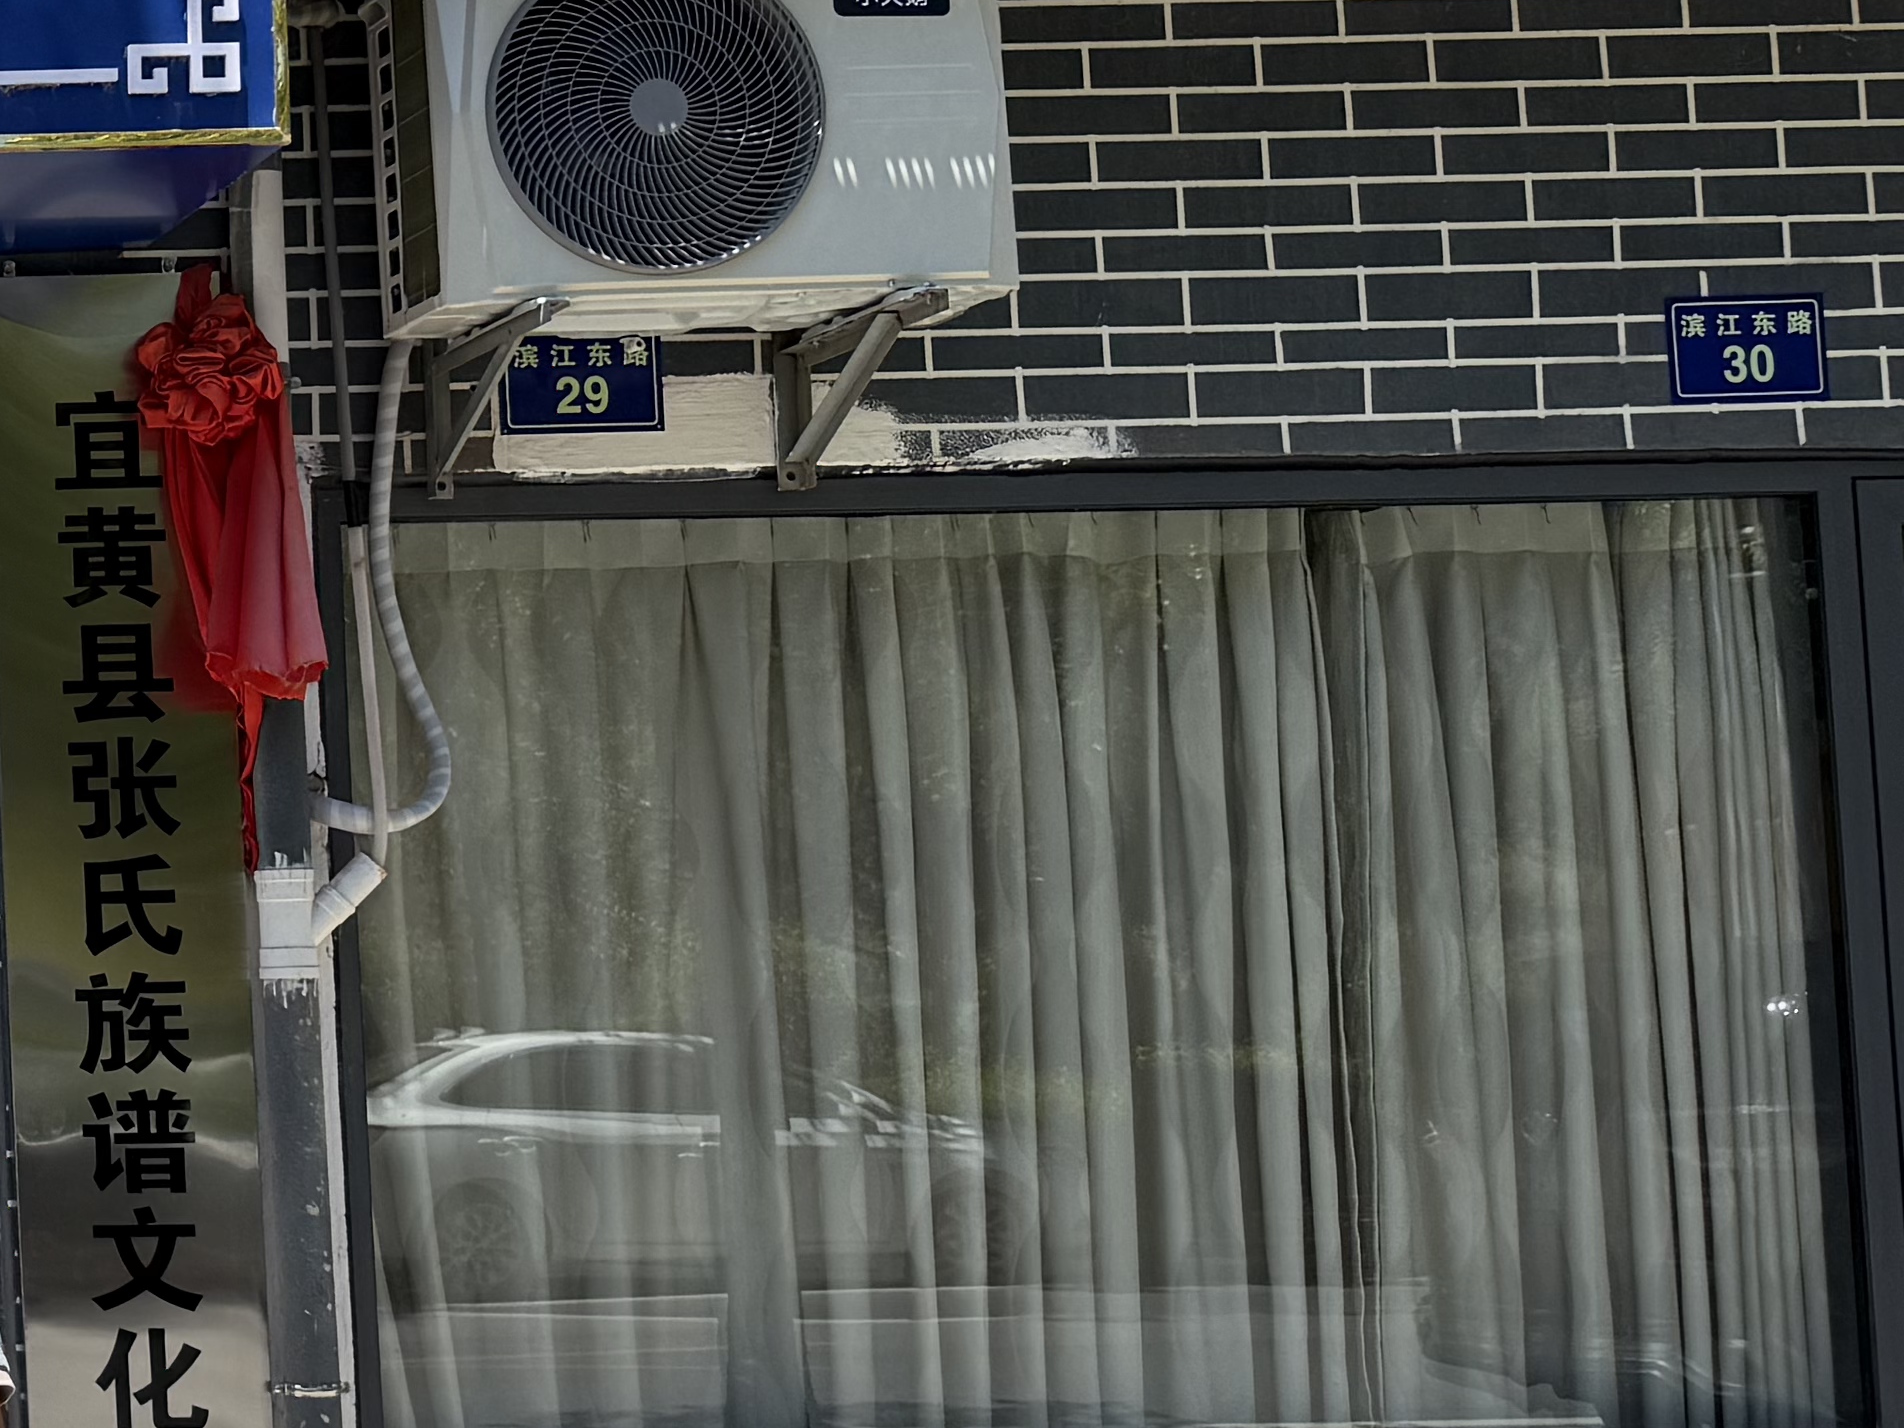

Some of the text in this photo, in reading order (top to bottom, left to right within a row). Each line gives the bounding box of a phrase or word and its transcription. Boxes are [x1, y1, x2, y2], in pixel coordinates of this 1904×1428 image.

[1680, 309, 1813, 338] 滨江东路
[1722, 344, 1775, 384] 30
[556, 375, 609, 414] 29
